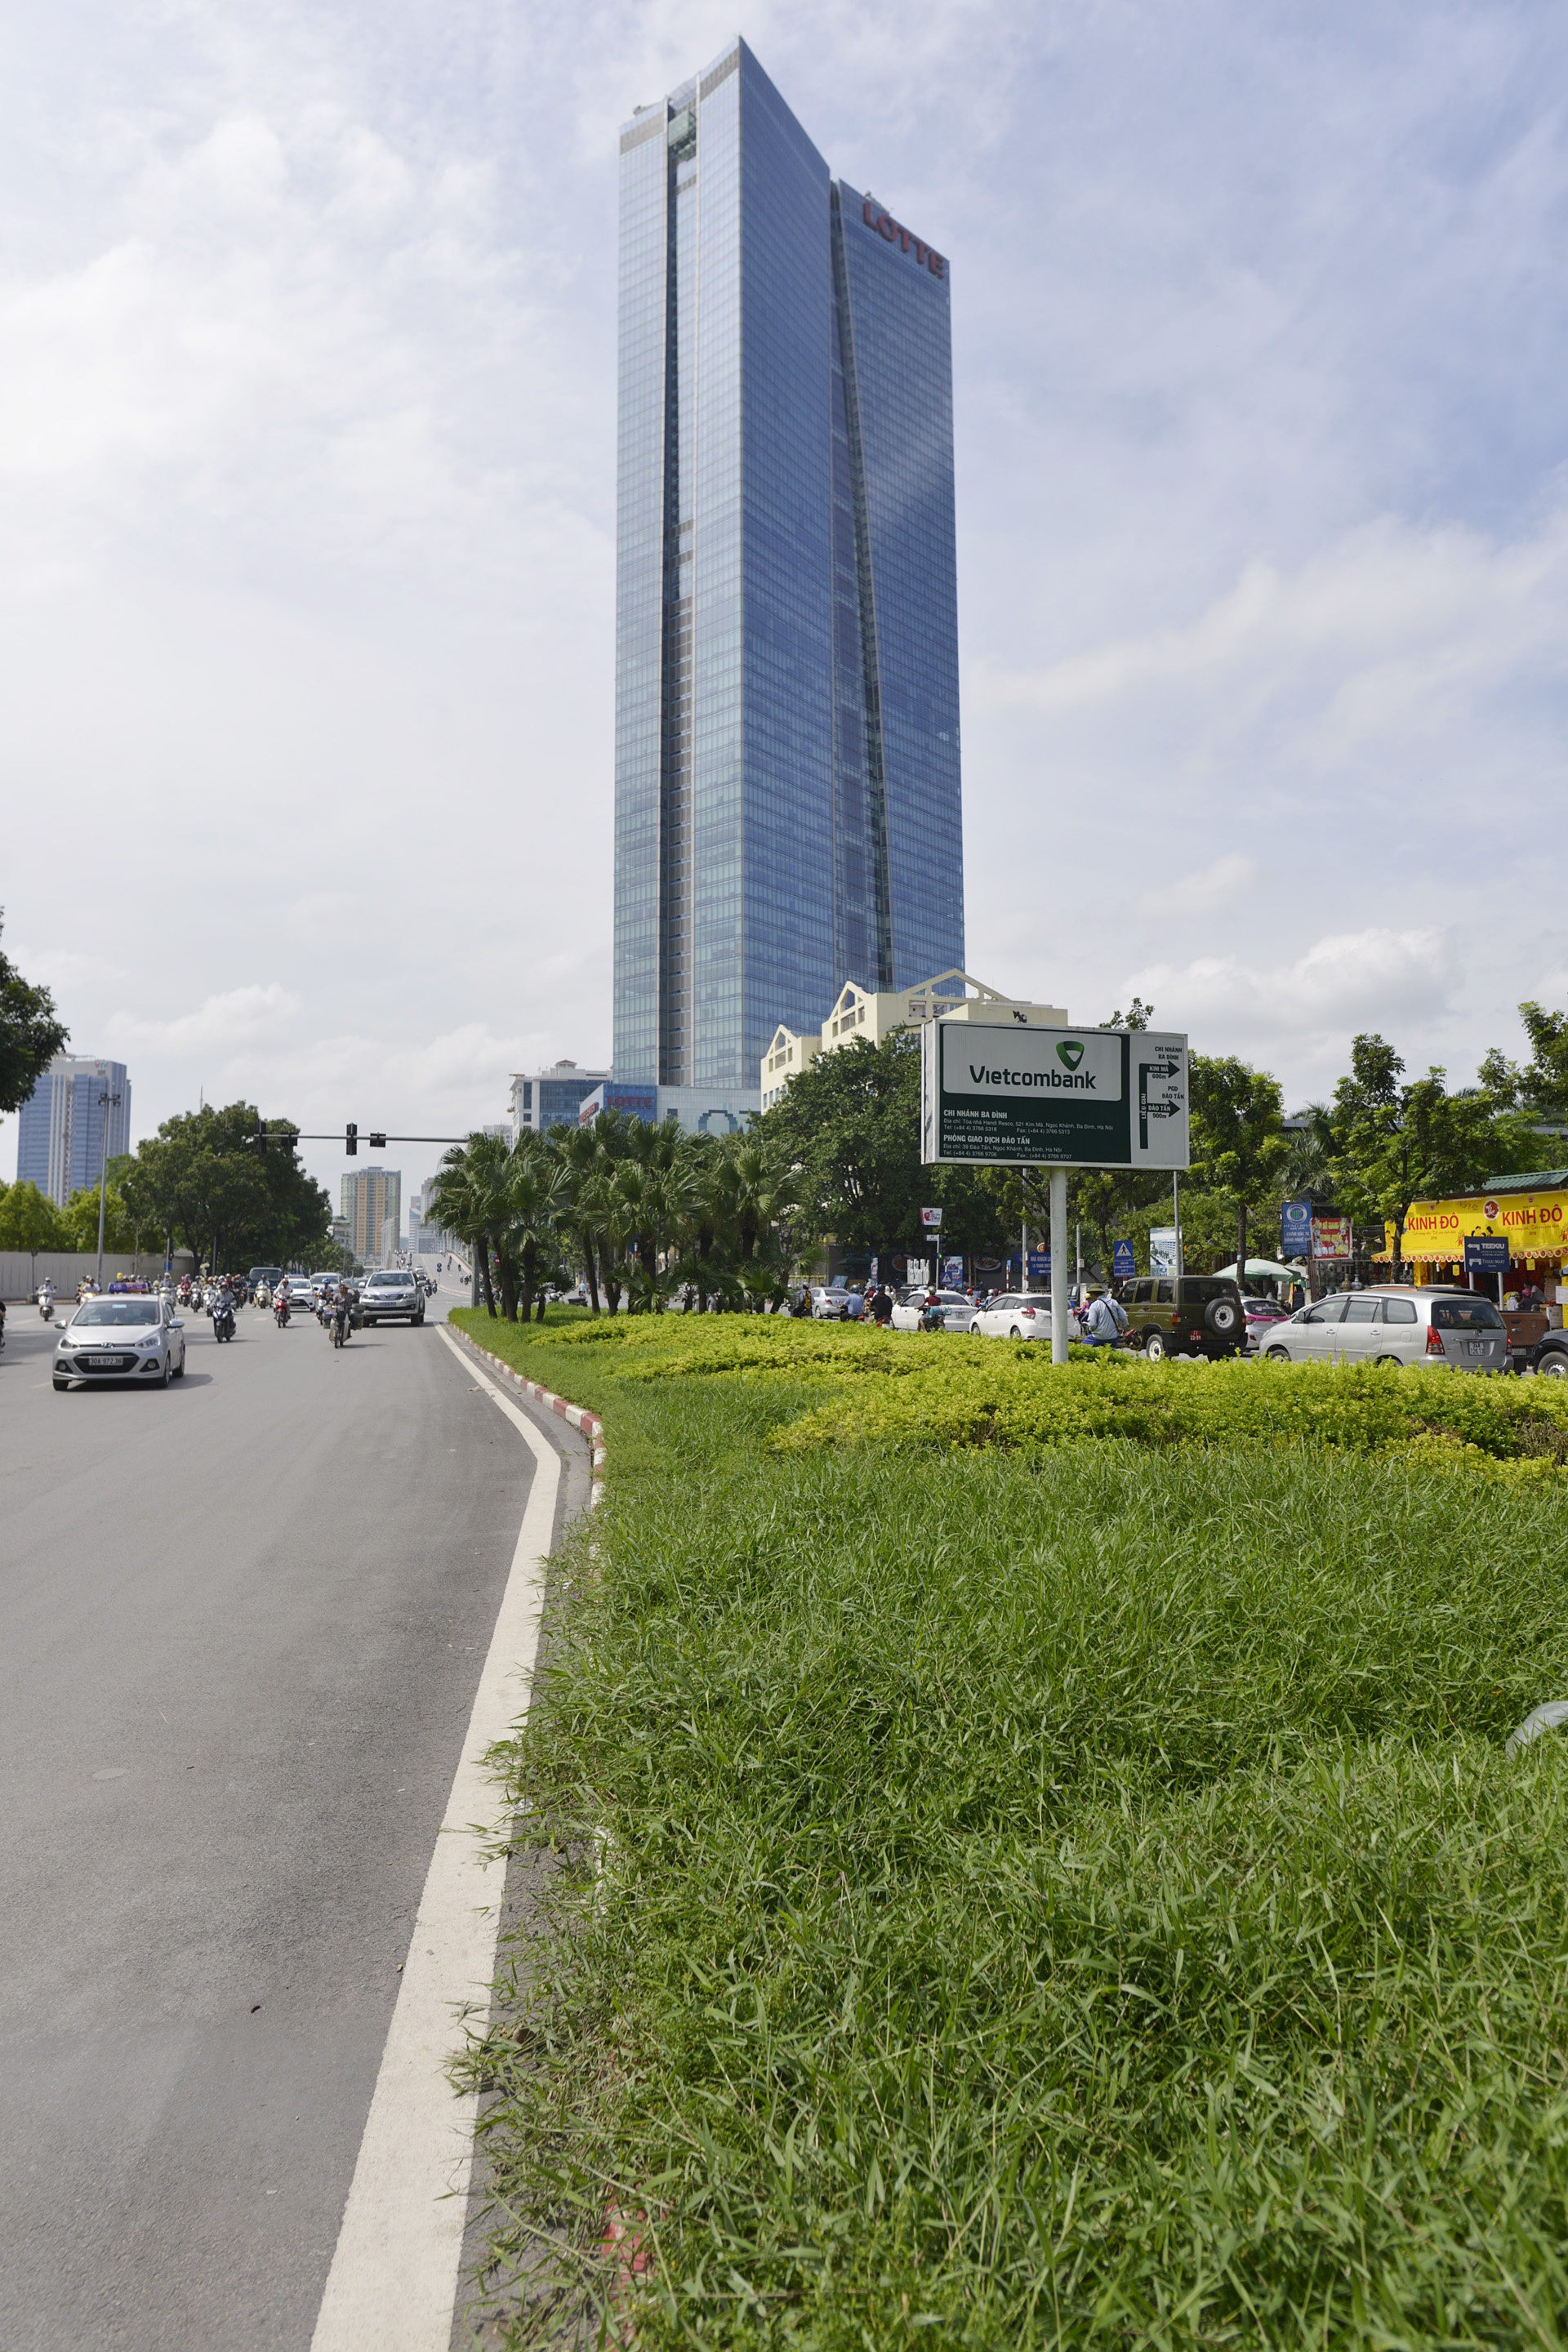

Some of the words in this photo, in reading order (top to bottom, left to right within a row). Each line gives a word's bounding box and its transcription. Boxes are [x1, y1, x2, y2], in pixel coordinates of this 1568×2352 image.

[863, 201, 945, 279] LOTTE
[969, 1064, 1097, 1089] Vietcombank
[607, 1096, 653, 1107] LOTTE
[956, 1109, 979, 1117] NHÁNH
[991, 1111, 1008, 1119] ĐÌNH
[943, 1134, 966, 1142] PHÒNG
[984, 1136, 1000, 1144] DỊCH
[1001, 1135, 1015, 1144] ĐÀO
[1408, 1216, 1437, 1231] KINH
[1440, 1212, 1459, 1229] ĐÔ
[1503, 1209, 1536, 1226] KINH
[1539, 1204, 1563, 1223] ĐÔ
